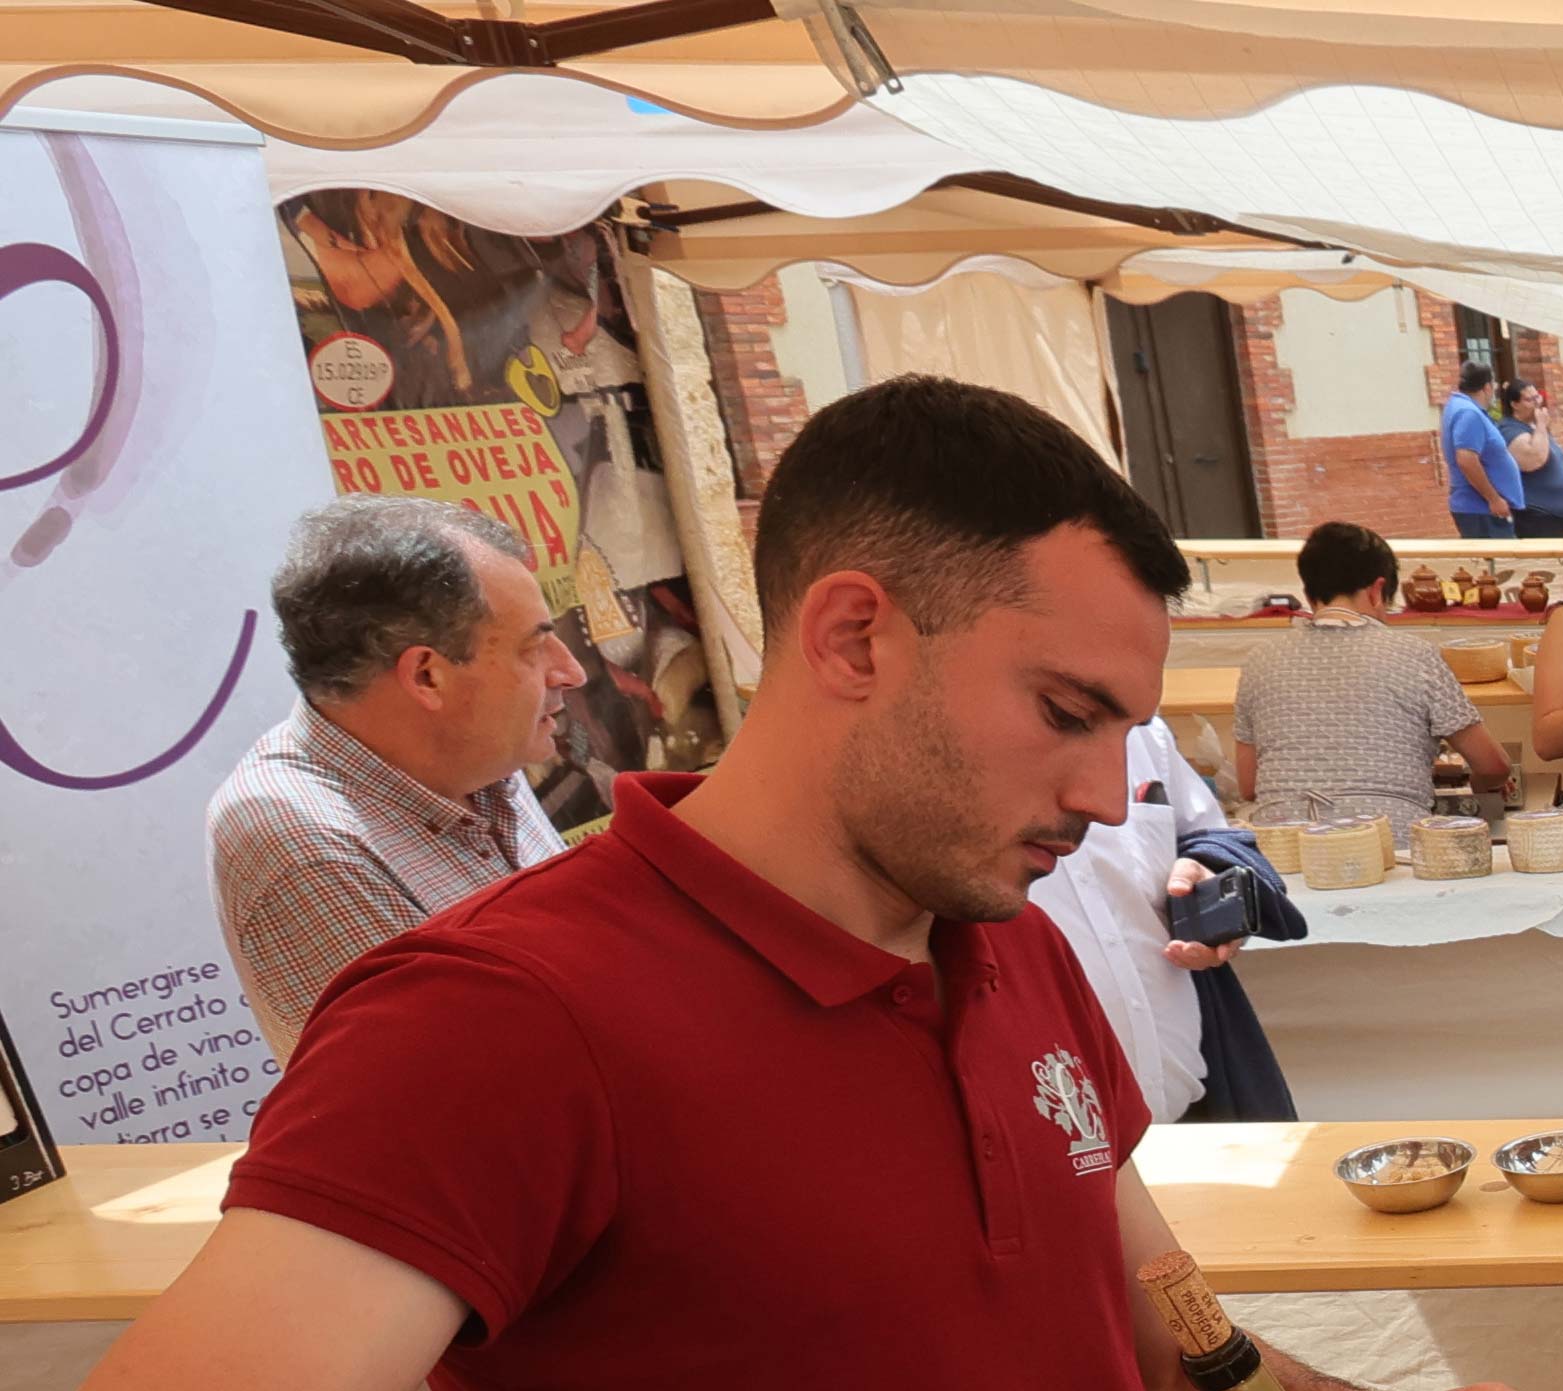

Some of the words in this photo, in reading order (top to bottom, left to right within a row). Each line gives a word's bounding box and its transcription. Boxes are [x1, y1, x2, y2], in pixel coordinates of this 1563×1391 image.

[322, 407, 543, 452] ARTESANALES
[390, 452, 440, 491] DE
[447, 442, 561, 485] OVEJA
[51, 962, 220, 1019] Sumergirse
[59, 1020, 103, 1057] del
[110, 994, 227, 1040] Cerrato
[59, 1061, 133, 1097] copa
[142, 1042, 177, 1071] de
[188, 1029, 260, 1056] vino.
[79, 1091, 146, 1130] valle
[153, 1063, 249, 1107] infinito
[200, 1108, 231, 1130] se
[1181, 1290, 1219, 1345] PROPIEDAD
